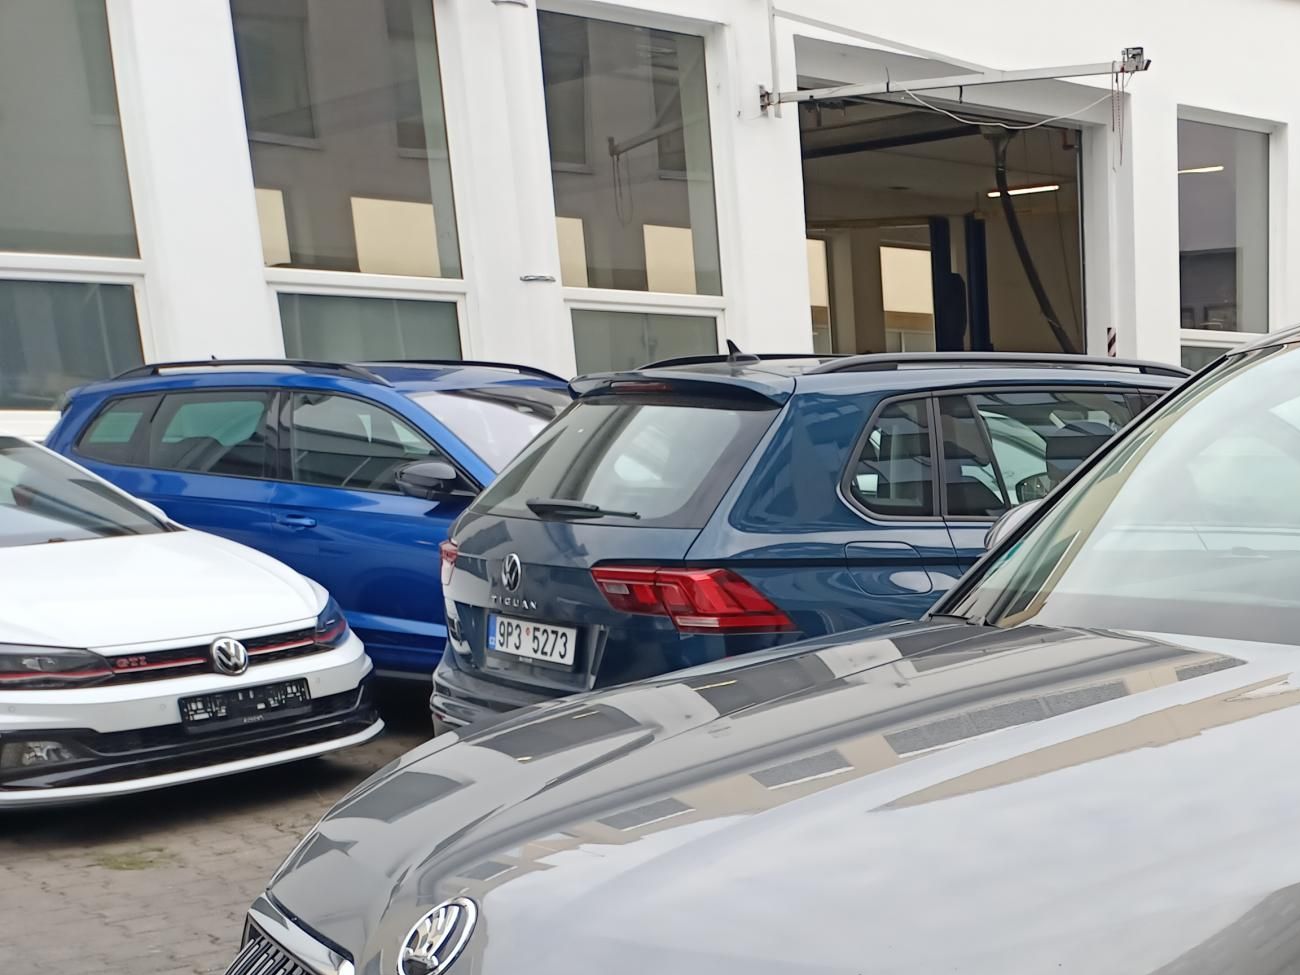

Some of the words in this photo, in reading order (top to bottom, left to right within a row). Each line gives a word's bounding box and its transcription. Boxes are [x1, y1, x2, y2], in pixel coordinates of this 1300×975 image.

[491, 595, 537, 609] TIGUAN
[498, 620, 522, 650] 9P3
[532, 625, 569, 659] 5273
[116, 655, 147, 668] GTI
